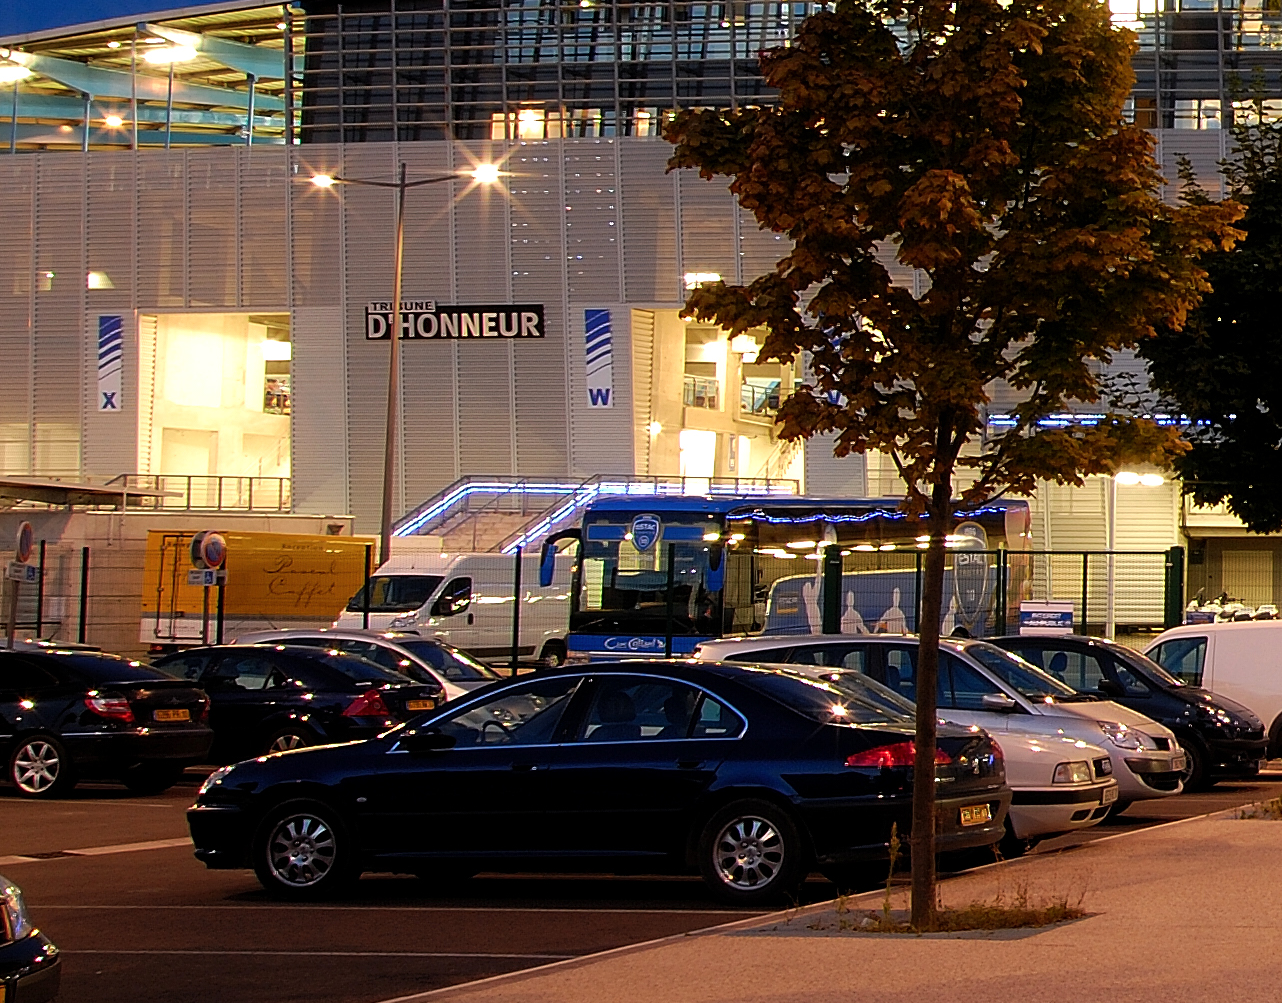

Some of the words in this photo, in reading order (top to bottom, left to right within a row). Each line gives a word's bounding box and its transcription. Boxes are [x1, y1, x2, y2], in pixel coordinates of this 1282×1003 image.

[367, 312, 541, 338] D'HONNEUR
[102, 392, 117, 409] X
[589, 388, 611, 406] W
